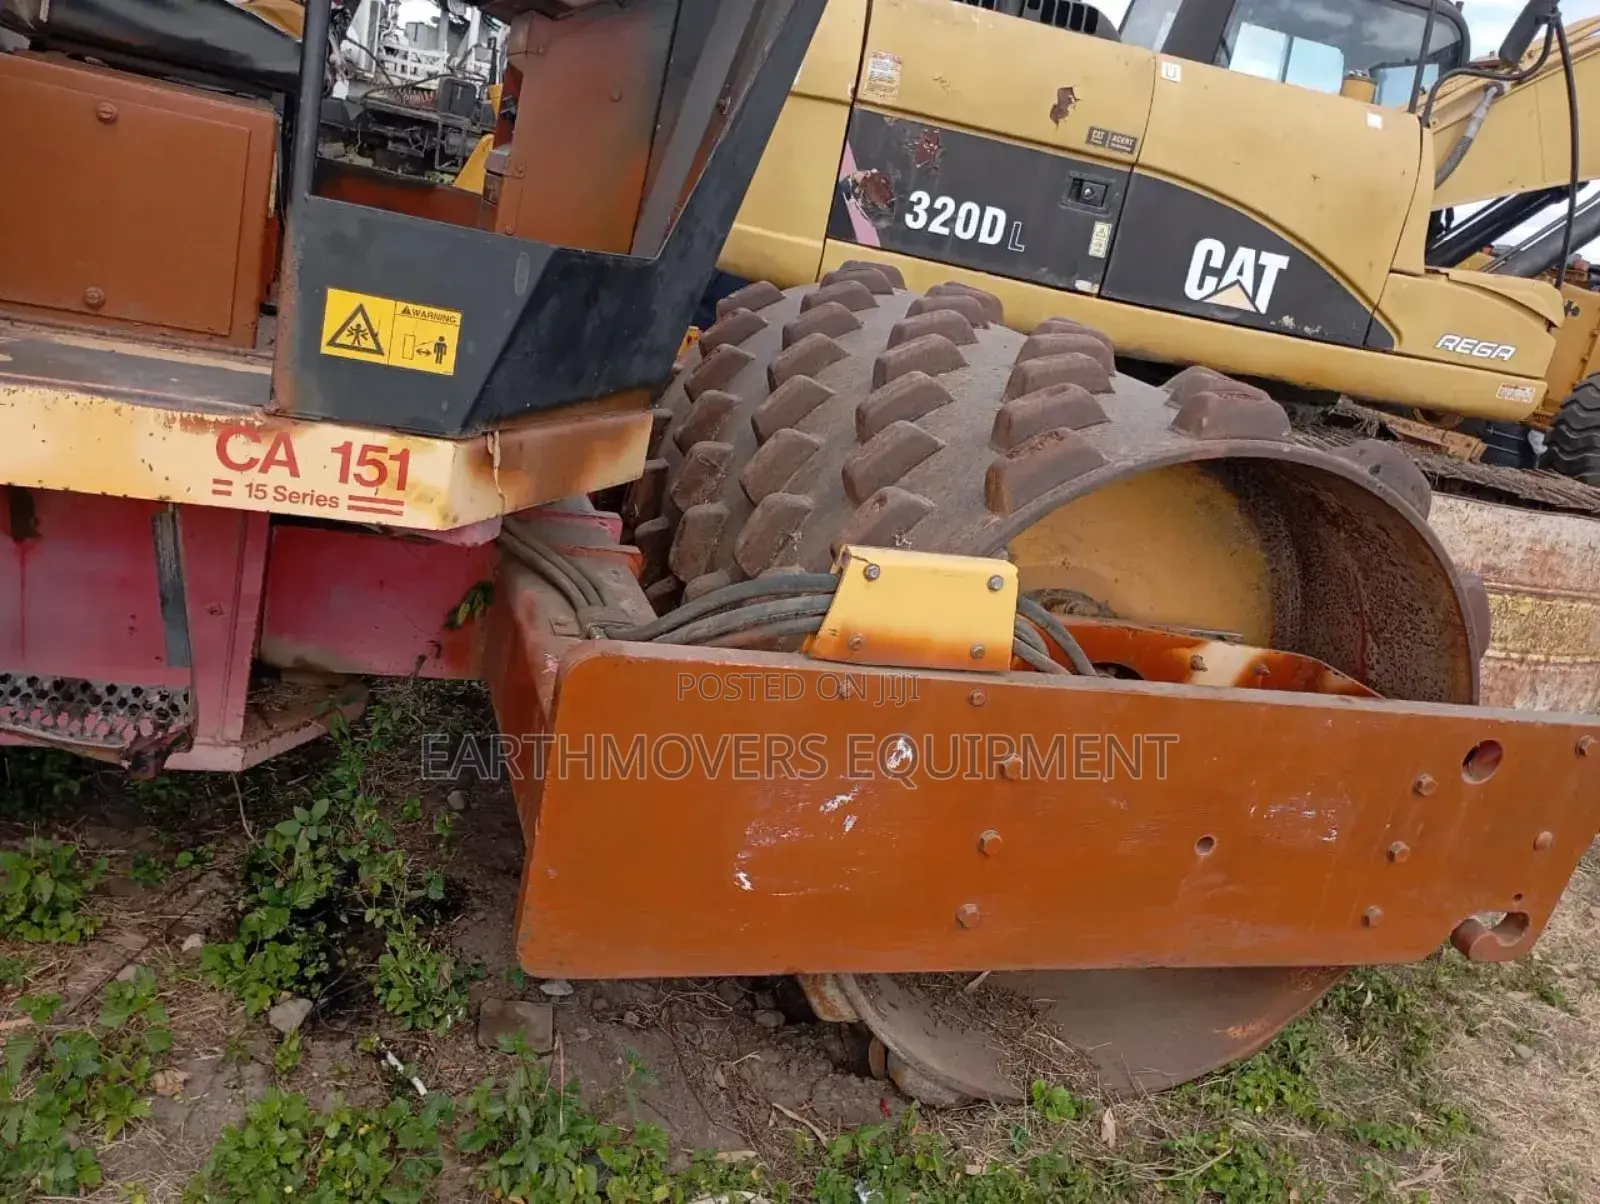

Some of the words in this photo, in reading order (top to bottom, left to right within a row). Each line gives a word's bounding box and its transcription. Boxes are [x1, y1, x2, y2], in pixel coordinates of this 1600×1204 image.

[905, 190, 1007, 245] 320D
[1184, 238, 1290, 315] CAT
[412, 307, 457, 323] WARNING
[1435, 333, 1516, 361] REGA
[216, 424, 300, 478] CA
[331, 440, 411, 491] 151
[244, 481, 268, 500] 15
[273, 485, 340, 508] Series
